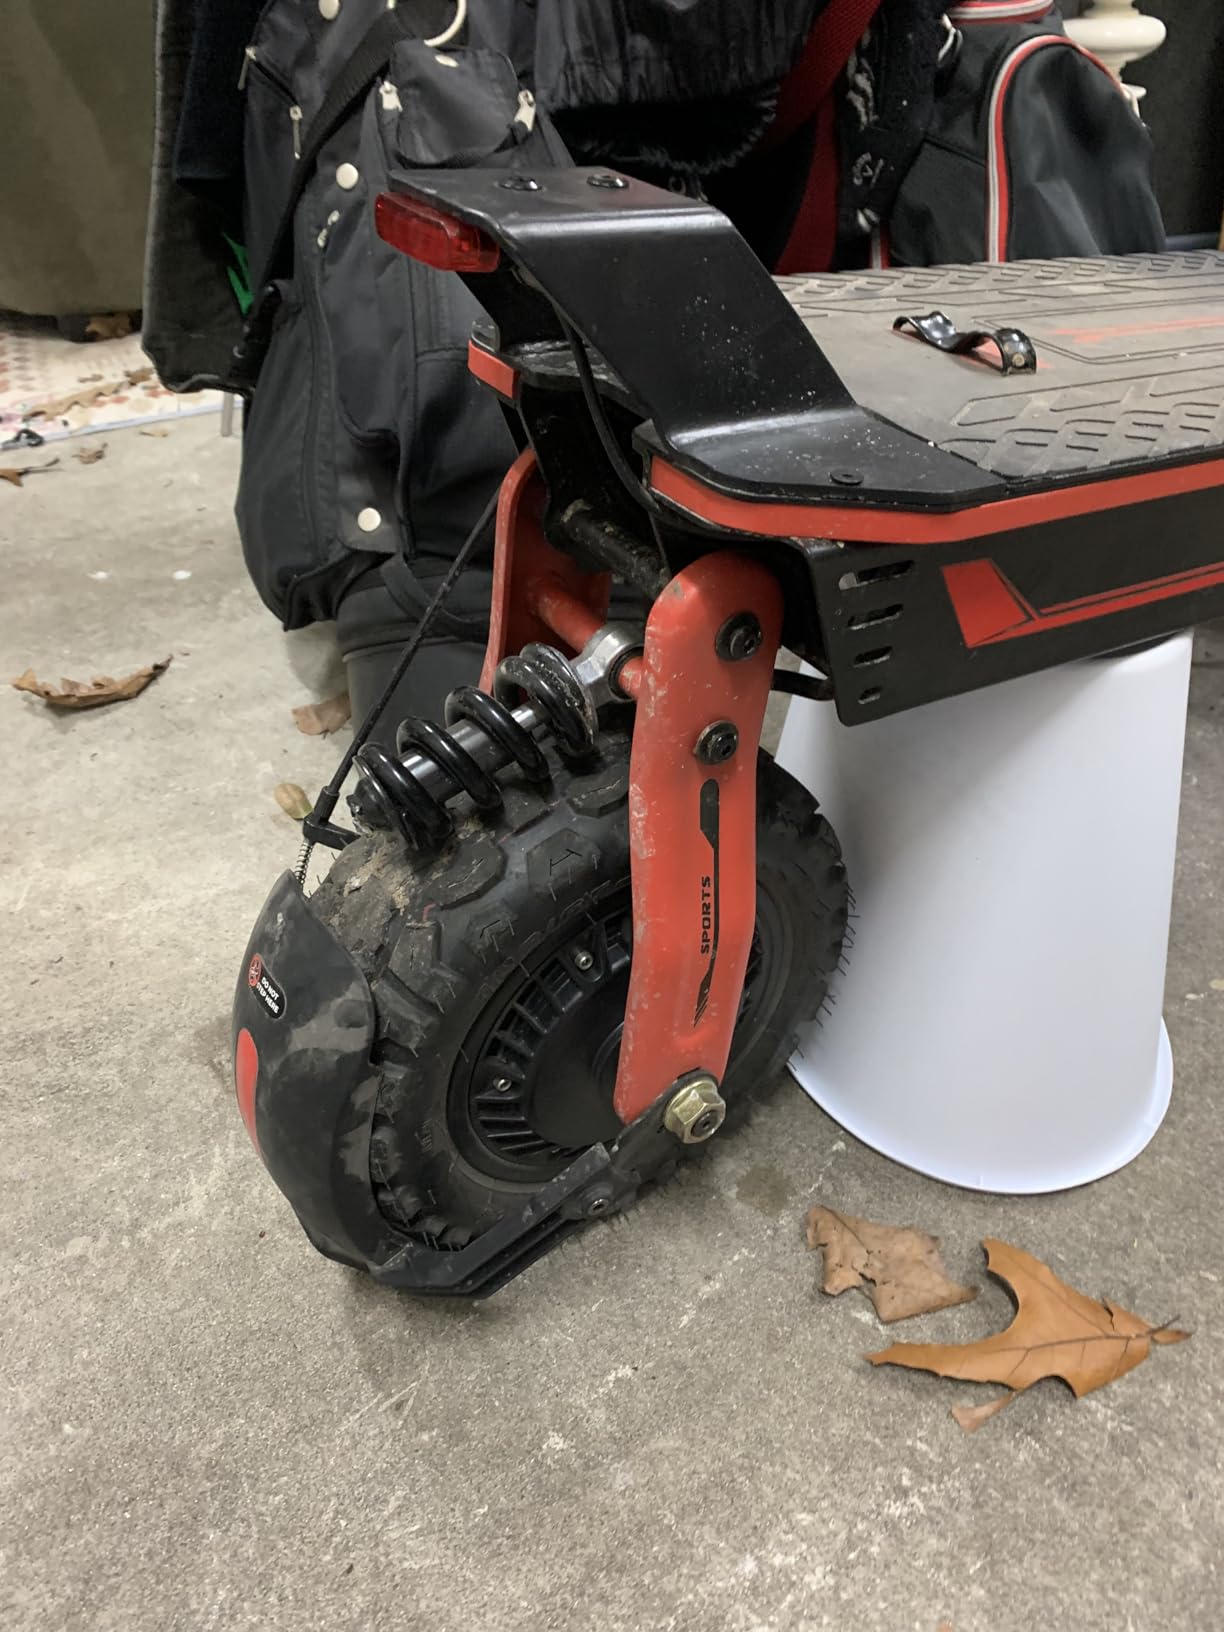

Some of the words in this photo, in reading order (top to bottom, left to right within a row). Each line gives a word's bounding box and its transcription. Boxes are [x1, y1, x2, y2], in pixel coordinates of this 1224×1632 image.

[701, 875, 711, 954] SPORTS
[256, 981, 267, 997] STEP
[264, 994, 280, 1014] HERE
[261, 976, 269, 988] DO
[267, 985, 279, 1000] NOT
